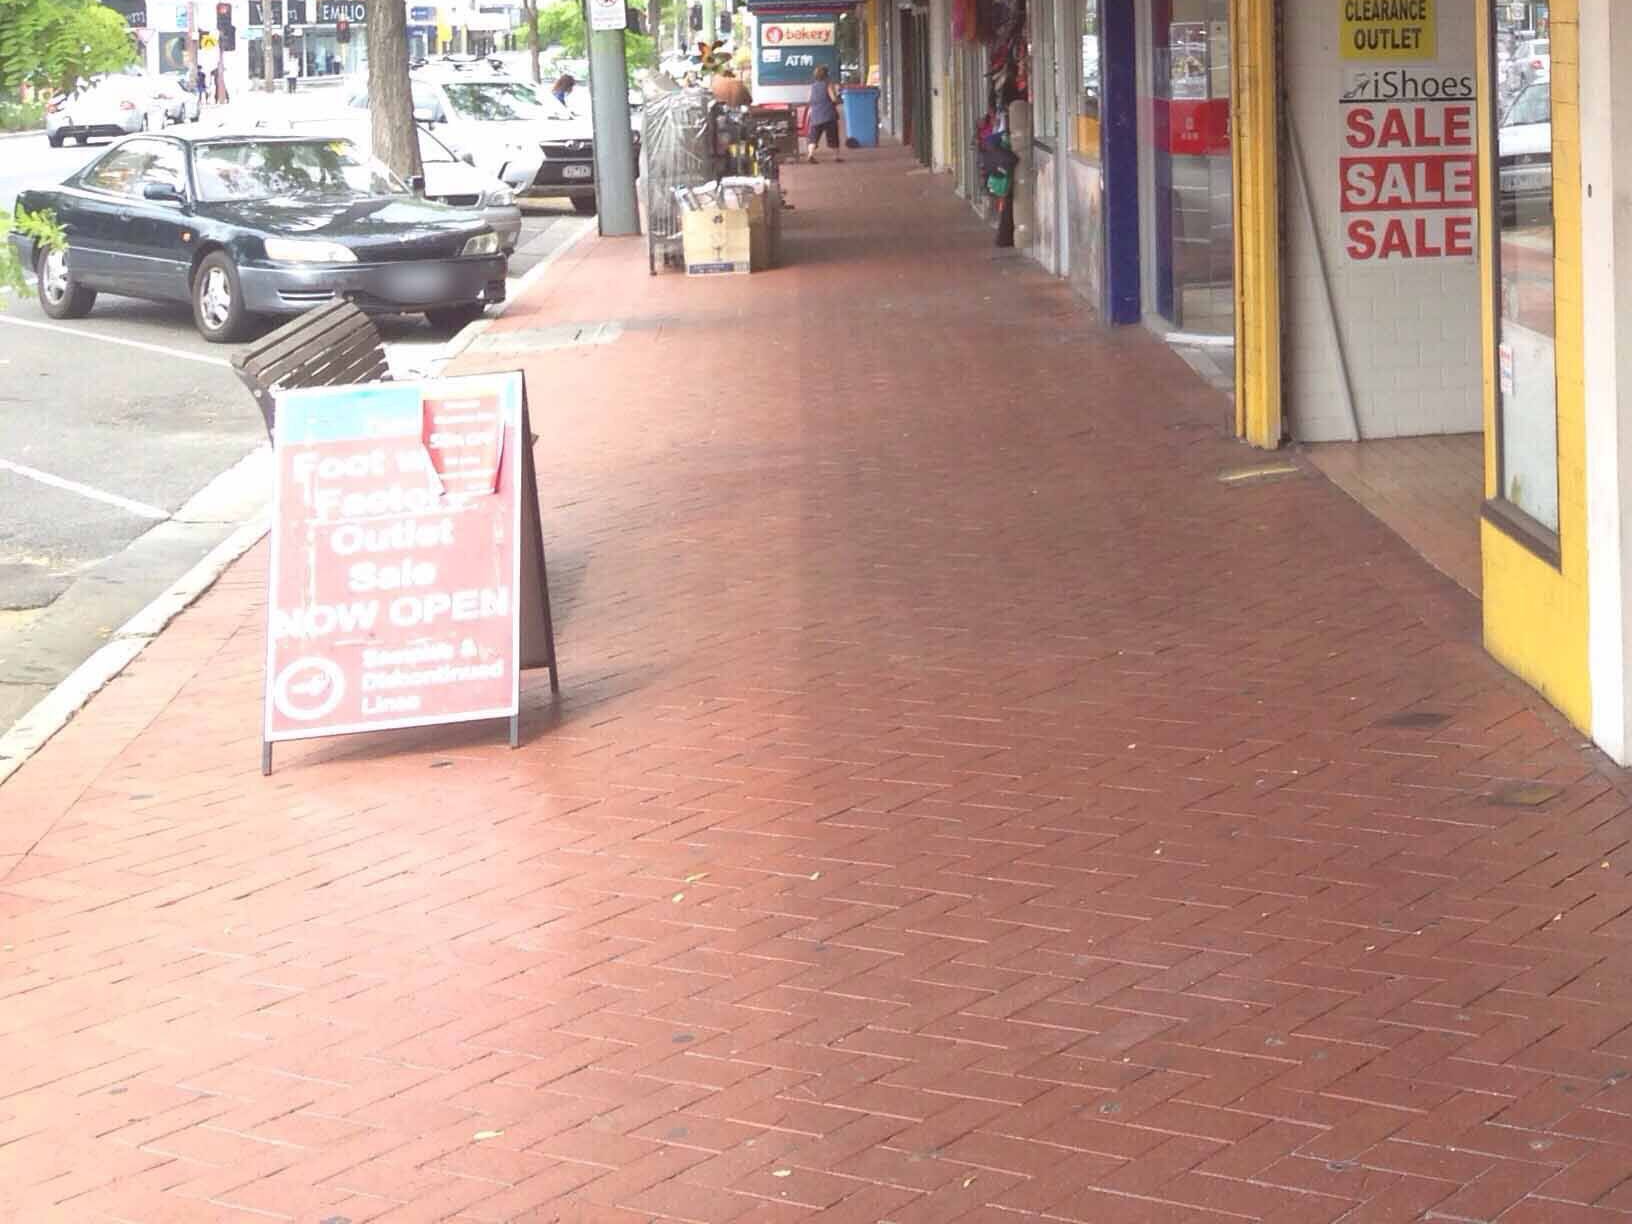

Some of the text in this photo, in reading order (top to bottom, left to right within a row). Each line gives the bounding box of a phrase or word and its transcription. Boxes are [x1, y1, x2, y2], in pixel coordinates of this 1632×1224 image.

[323, 5, 366, 21] EMILIO
[1345, 0, 1427, 22] CLEARANCE
[1354, 28, 1422, 50] OUTLET
[785, 55, 813, 67] ATM
[1374, 70, 1473, 98] iShoes
[1346, 105, 1471, 149] SALE
[1346, 161, 1473, 205] SALE
[1347, 217, 1473, 260] SALE
[331, 517, 455, 555] Outlet
[348, 559, 437, 592] Sale
[273, 587, 511, 638] NOW OPEN
